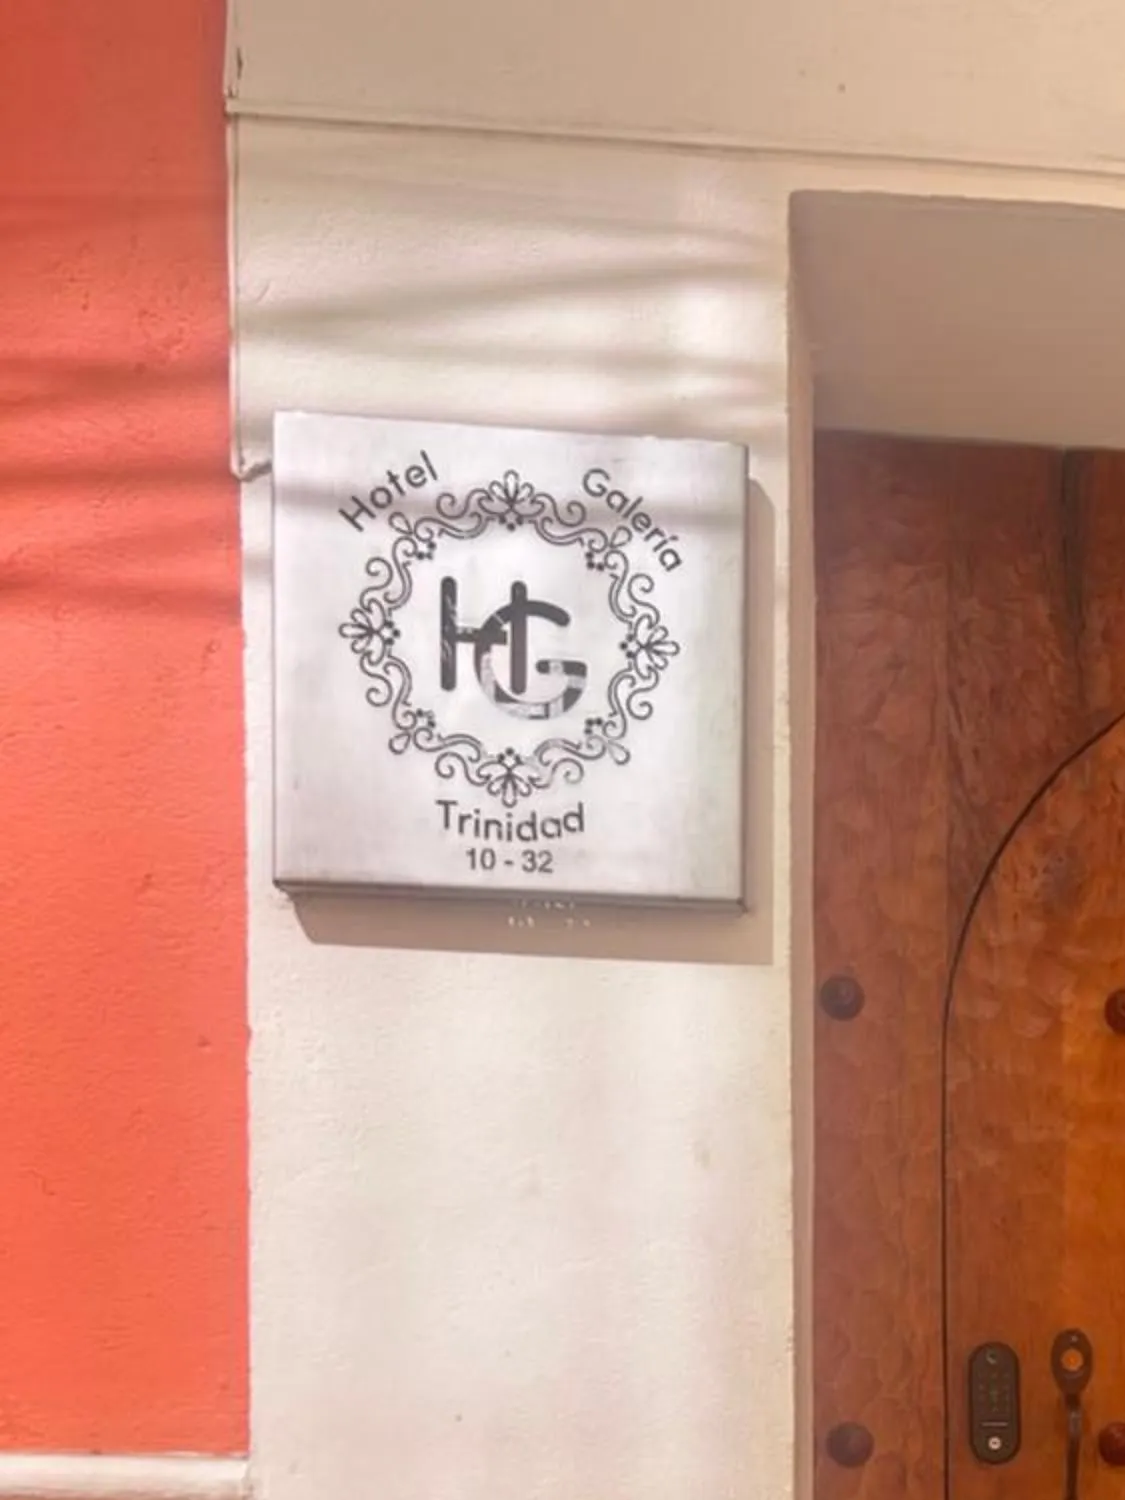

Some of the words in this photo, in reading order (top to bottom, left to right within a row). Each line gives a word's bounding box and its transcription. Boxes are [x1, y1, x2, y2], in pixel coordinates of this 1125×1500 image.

[338, 449, 438, 532] Hotel
[582, 468, 682, 571] Galería
[435, 799, 585, 842] Trinidad
